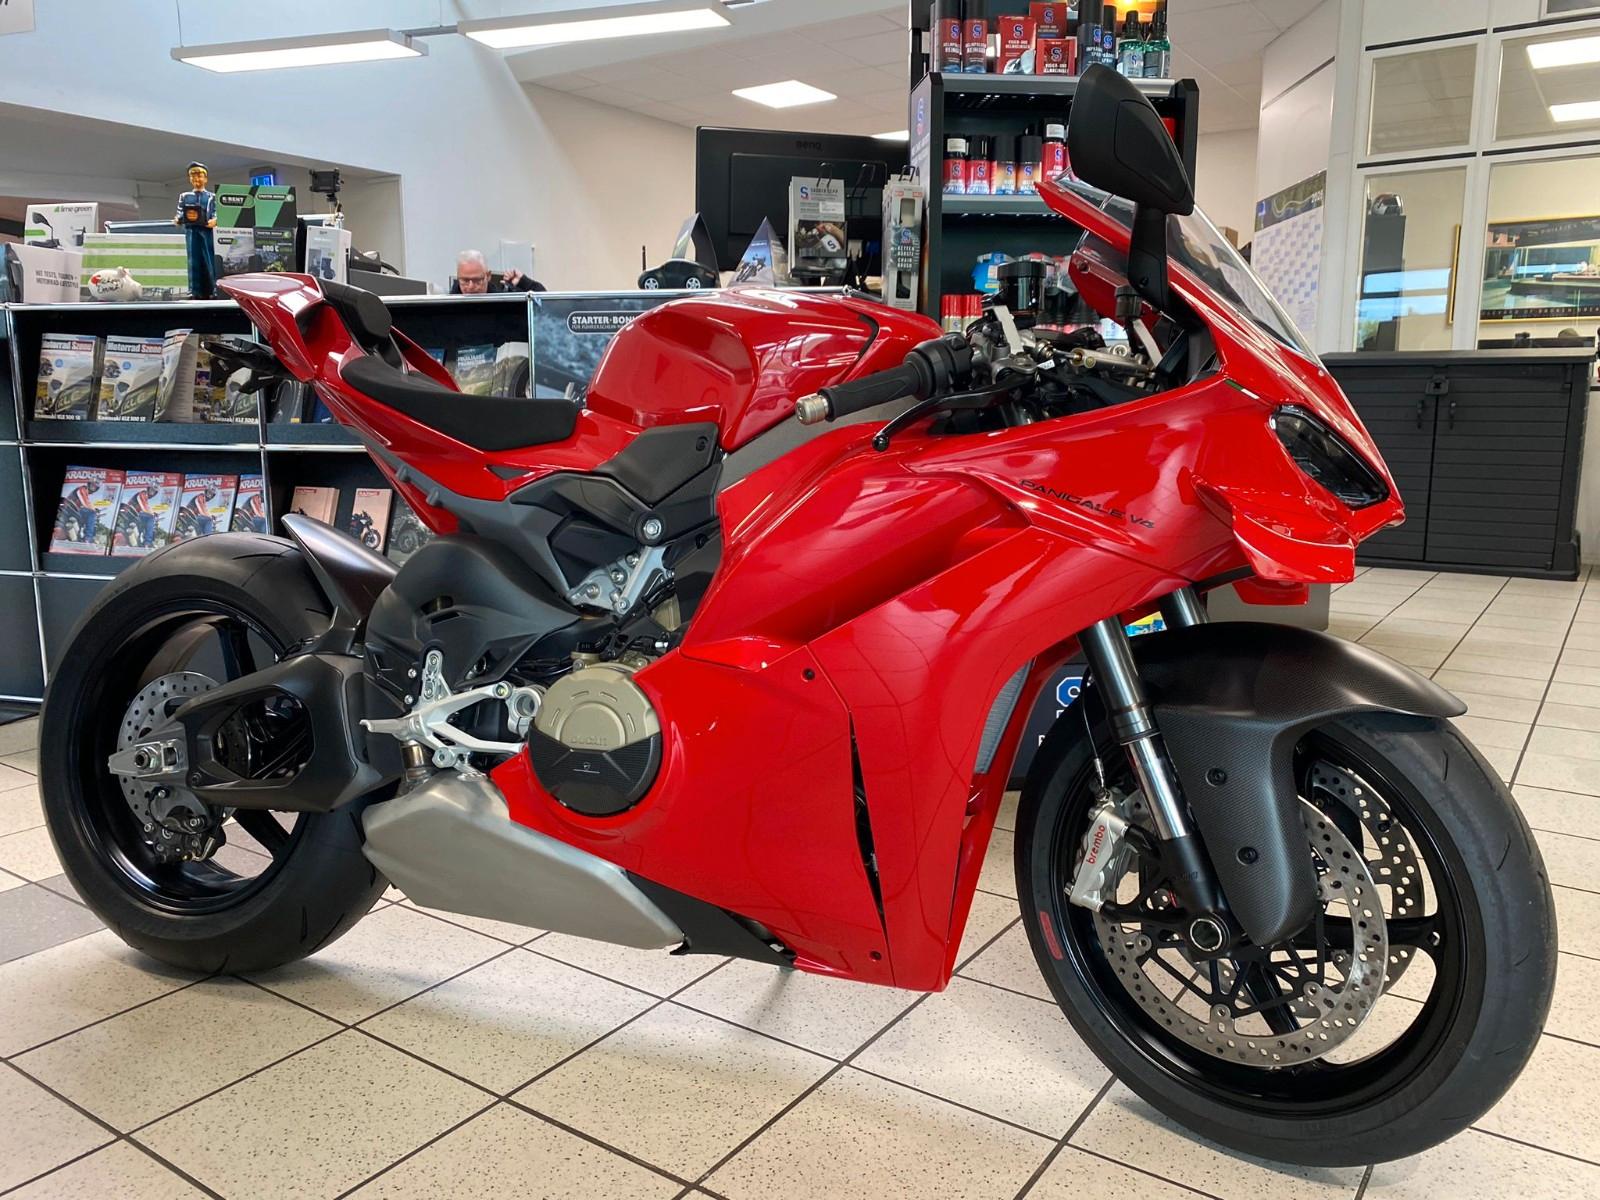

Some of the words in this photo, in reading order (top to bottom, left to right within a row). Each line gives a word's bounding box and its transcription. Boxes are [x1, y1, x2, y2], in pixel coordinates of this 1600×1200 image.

[1019, 479, 1126, 520] PANIGALE
[1130, 514, 1156, 529] V4
[1086, 825, 1106, 865] brembo
